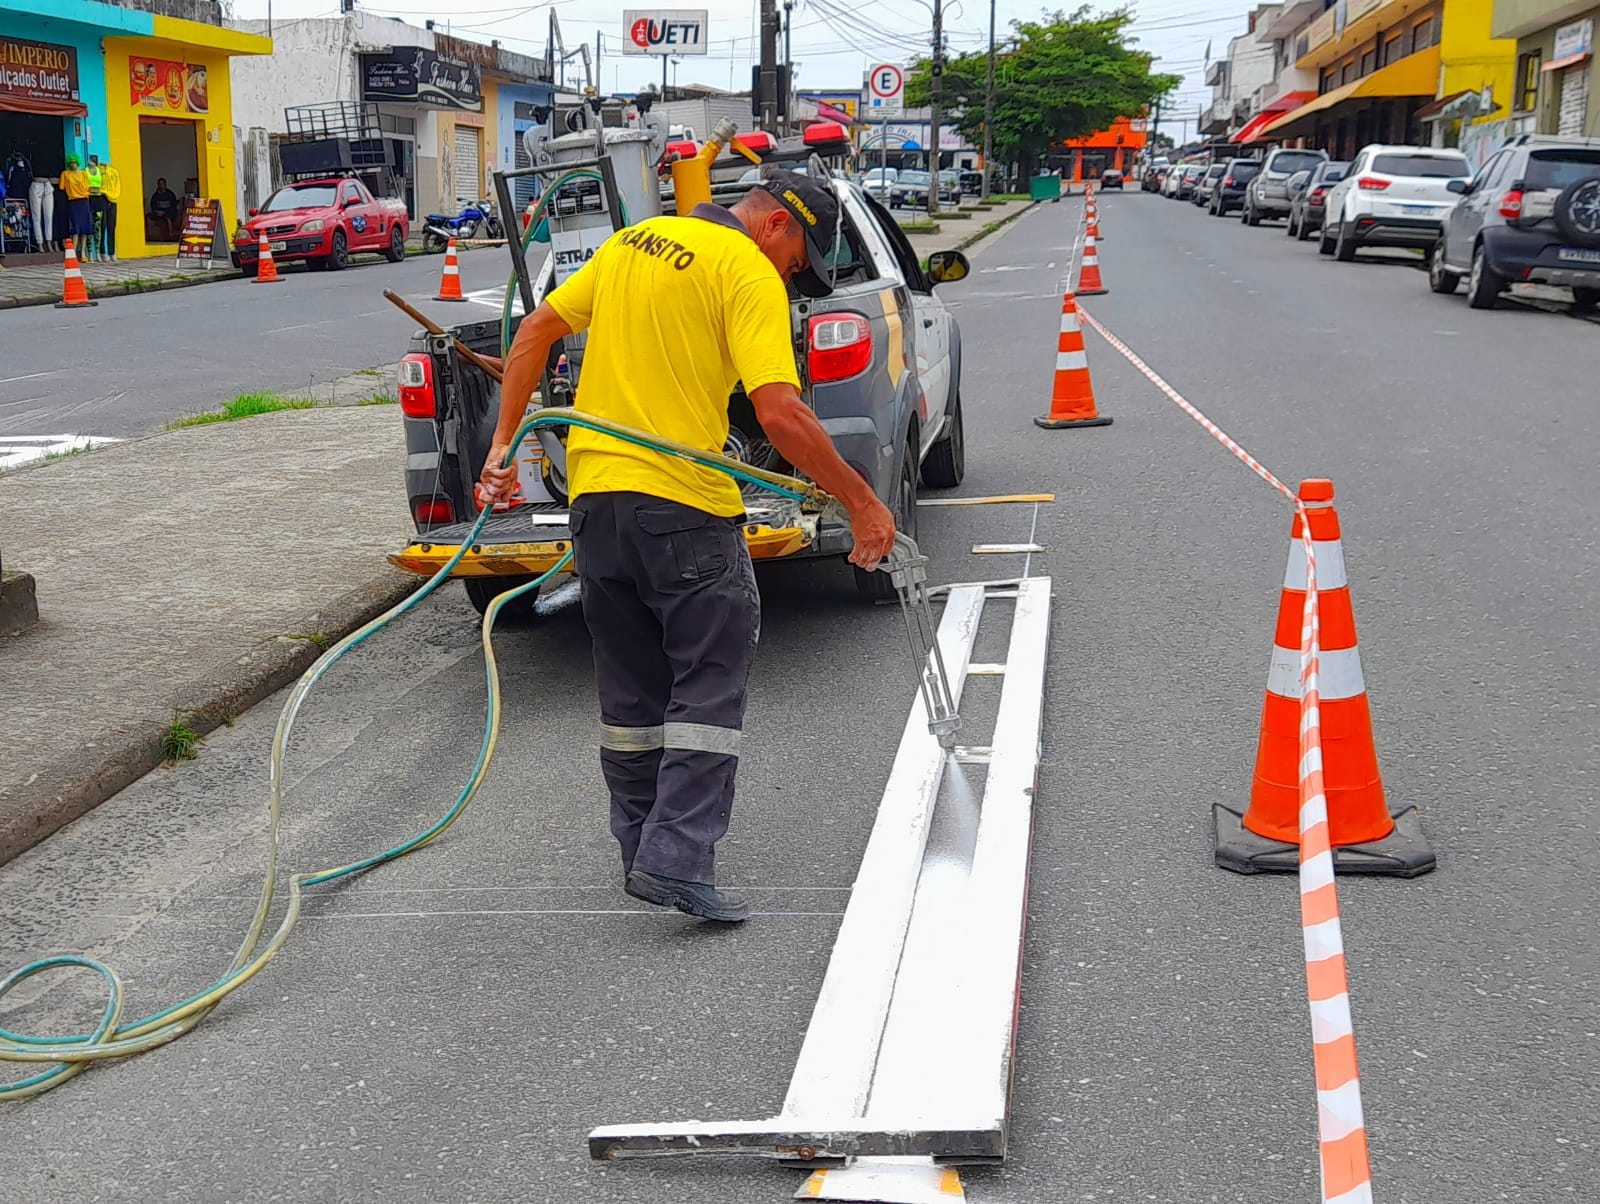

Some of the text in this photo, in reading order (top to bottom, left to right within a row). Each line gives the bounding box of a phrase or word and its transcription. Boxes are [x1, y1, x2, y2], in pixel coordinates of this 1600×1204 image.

[647, 19, 699, 45] UETI
[8, 42, 69, 71] IMPÉRIO
[39, 70, 70, 92] Outlet
[881, 72, 892, 90] E
[555, 246, 601, 266] SETRA
